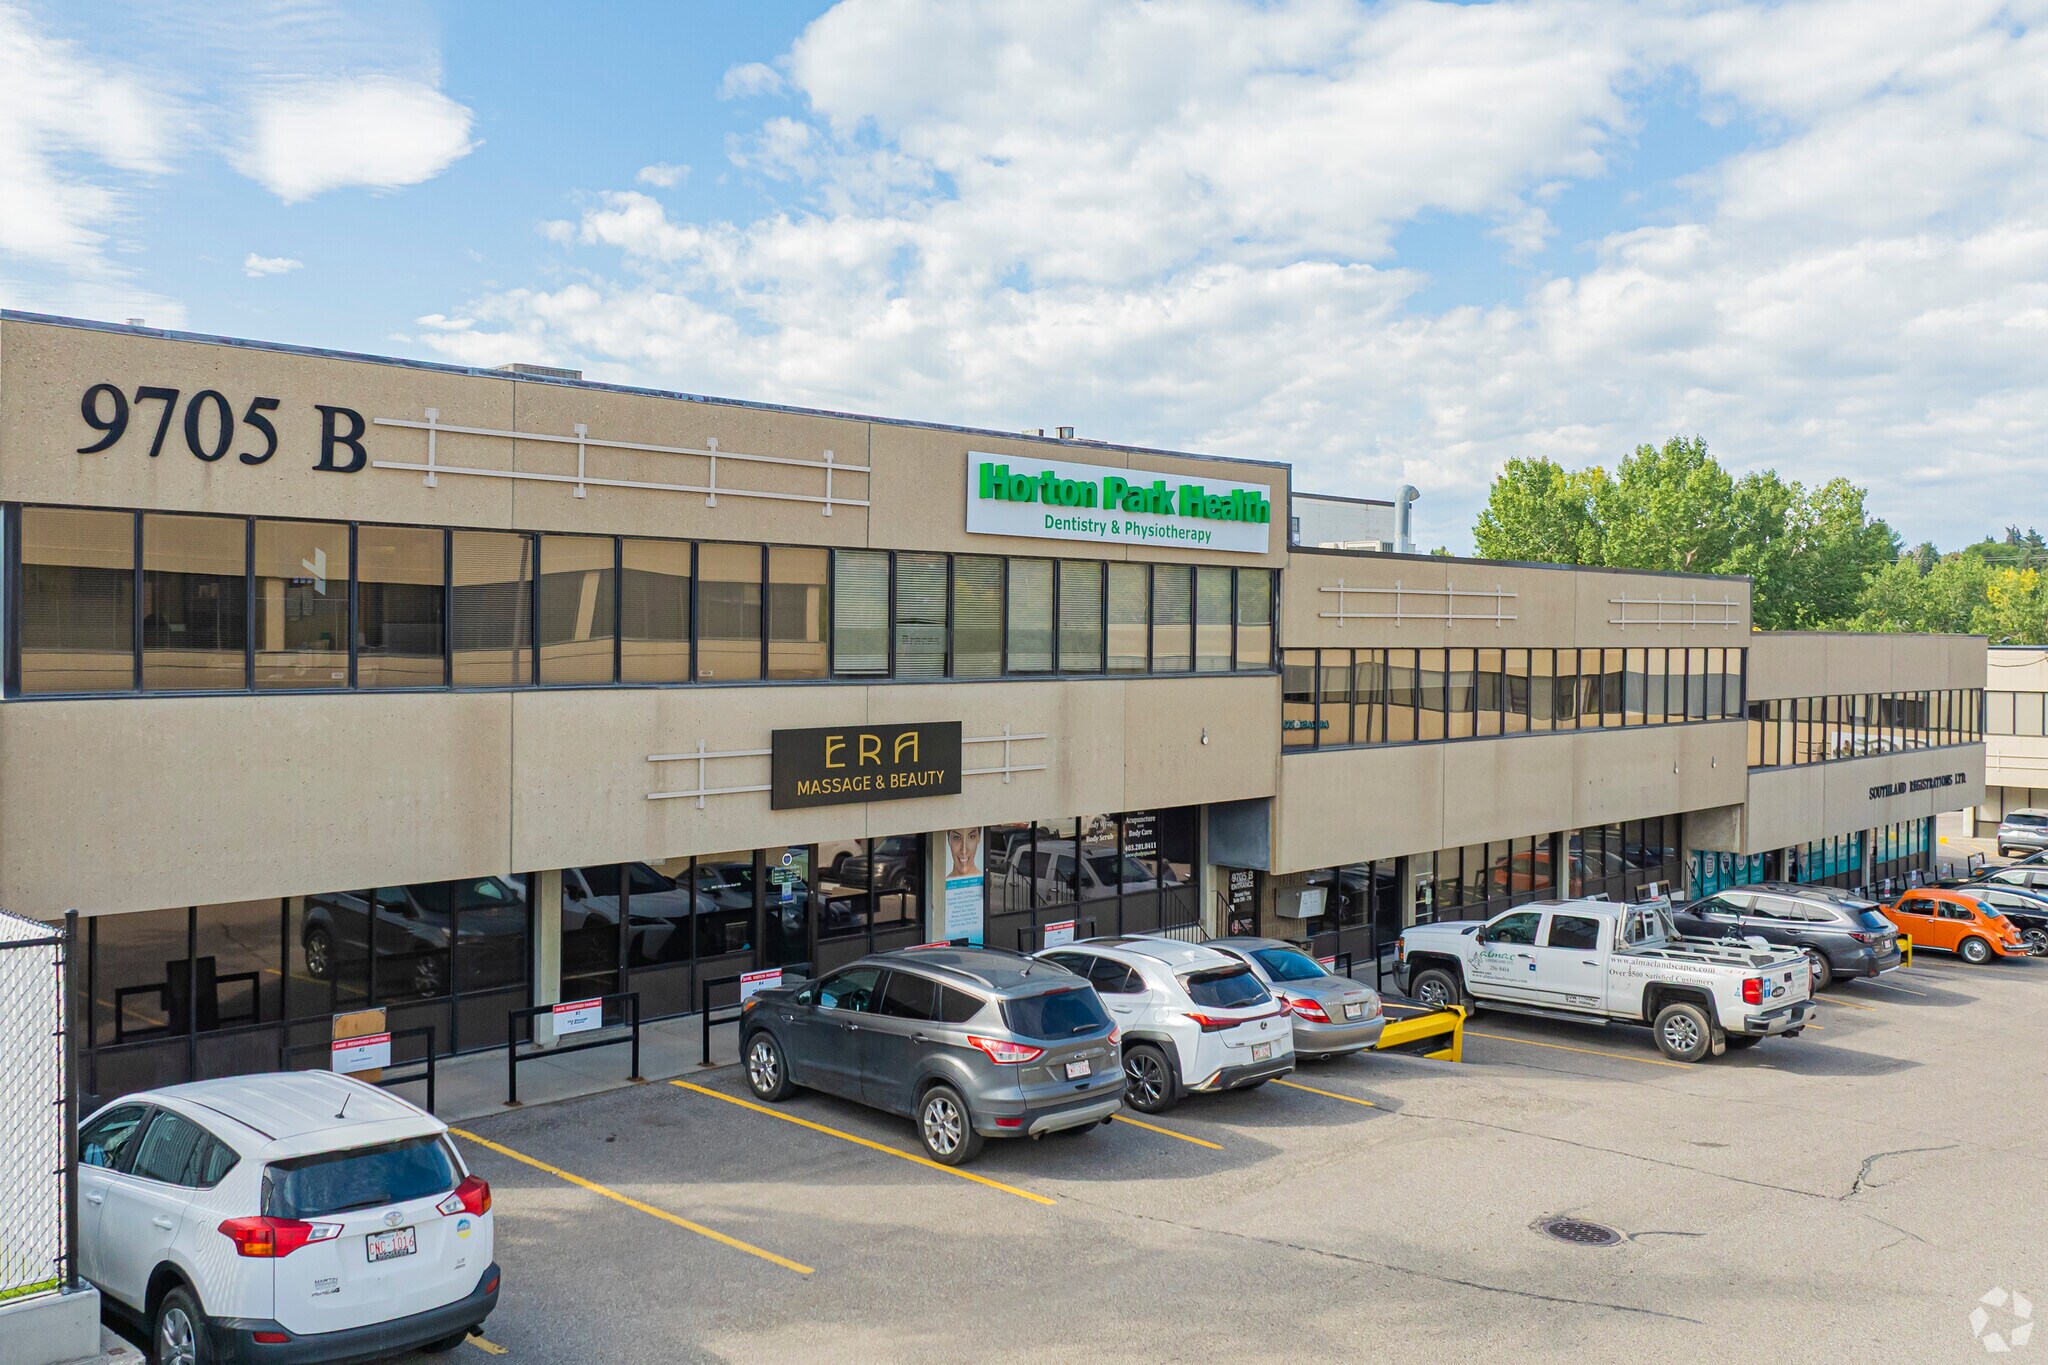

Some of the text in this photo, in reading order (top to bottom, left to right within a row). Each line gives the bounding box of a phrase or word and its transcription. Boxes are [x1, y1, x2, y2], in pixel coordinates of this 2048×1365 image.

[77, 383, 367, 473] 9705 B
[979, 462, 1271, 523] Horton Park Health
[1044, 514, 1211, 544] Dentistry & Physiotherapy
[825, 731, 918, 768] ERA
[797, 770, 945, 796] MASSAGE & BEAUTY
[1869, 782, 1907, 800] SOUTHLAND
[1909, 774, 1953, 792] REGISTRATIONS
[1100, 820, 1114, 828] Wrap
[1126, 816, 1156, 824] Acupuncture
[1086, 833, 1114, 843] Body Scrub
[1128, 830, 1141, 838] Body
[1231, 870, 1254, 882] 9705 B
[1231, 880, 1254, 891] ENTRANCE
[1480, 949, 1516, 960] almac
[1611, 956, 1716, 974] www.almaclandscapes.com
[1609, 968, 1625, 977] Over
[1644, 972, 1674, 982] Satisfied
[1675, 975, 1714, 986] Customers
